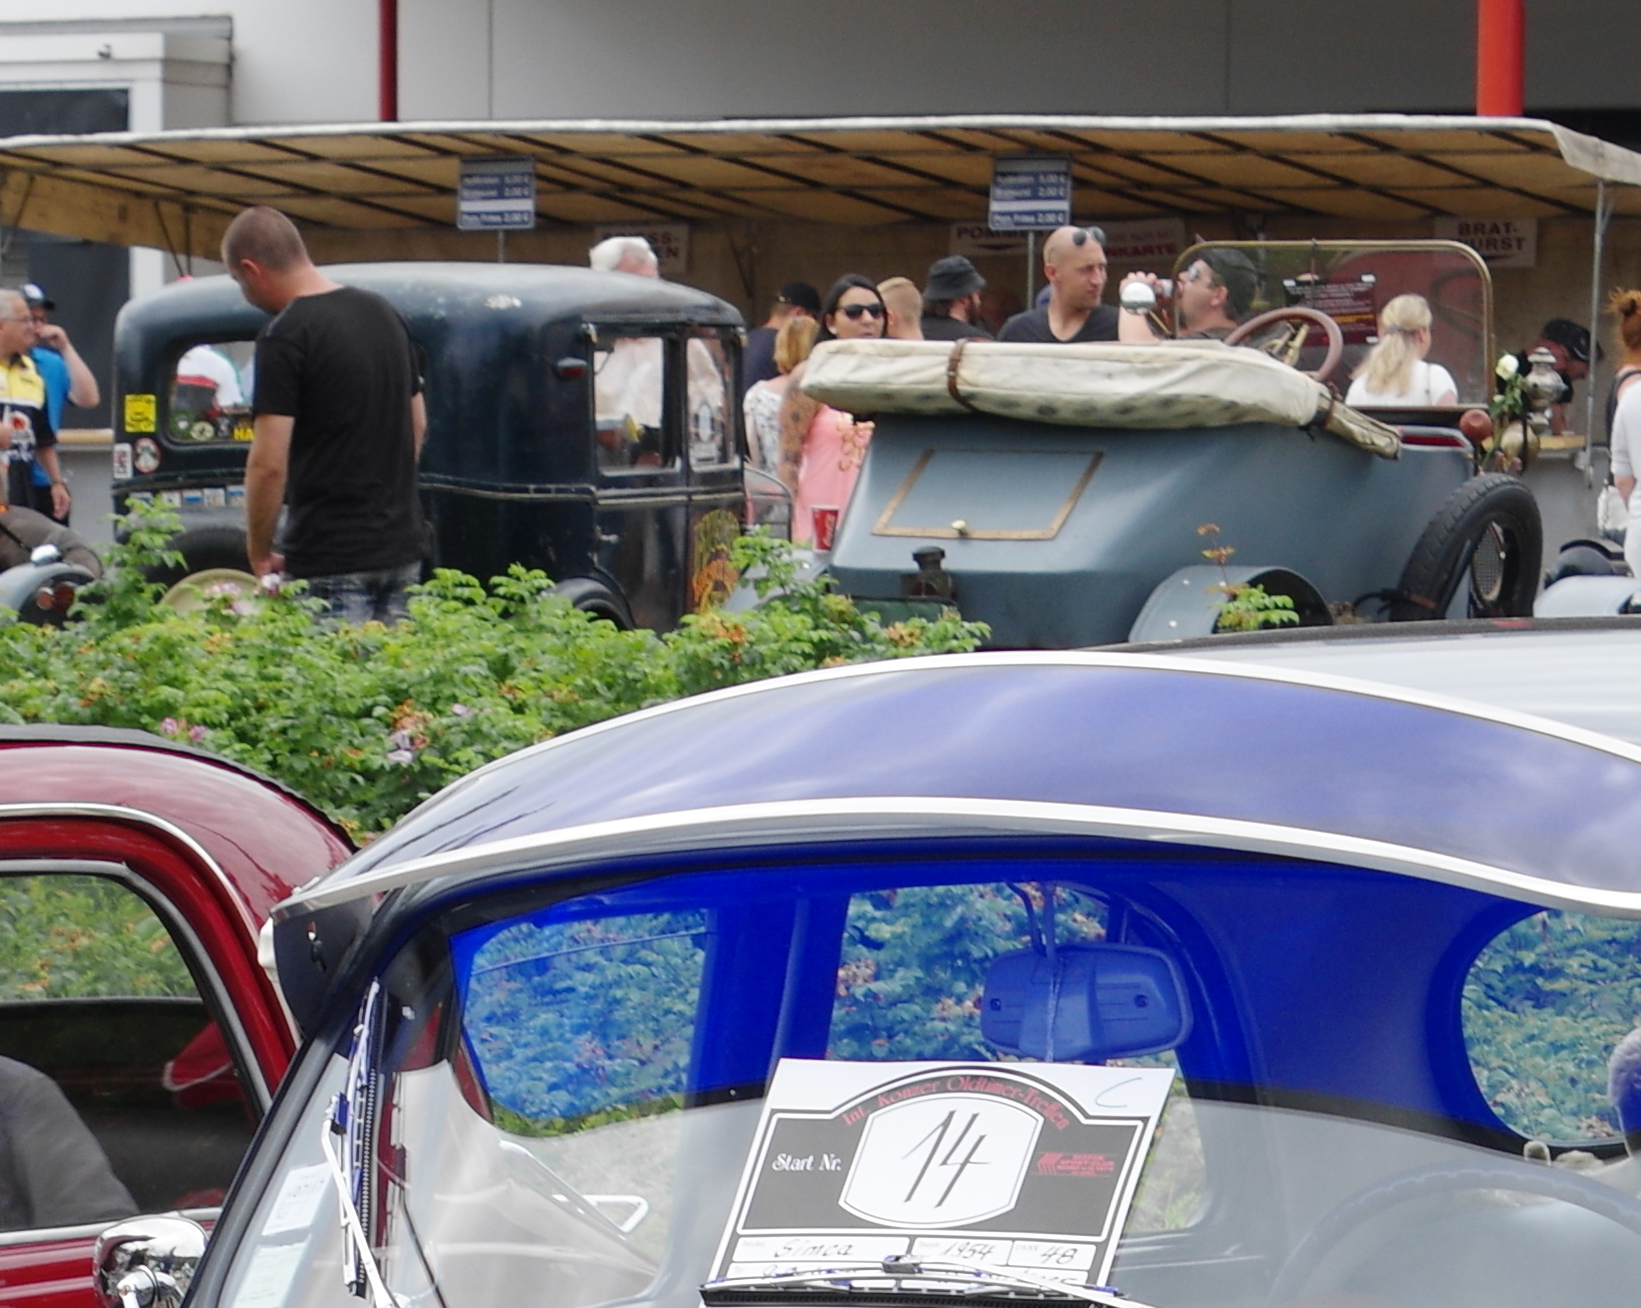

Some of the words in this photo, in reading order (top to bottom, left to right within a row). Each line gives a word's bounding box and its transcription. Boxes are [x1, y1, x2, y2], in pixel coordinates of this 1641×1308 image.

[771, 1152, 815, 1173] Start
[818, 1153, 843, 1172] Nr.
[901, 1109, 992, 1208] 14
[774, 1238, 855, 1259] Simca
[943, 1241, 996, 1261] 1954
